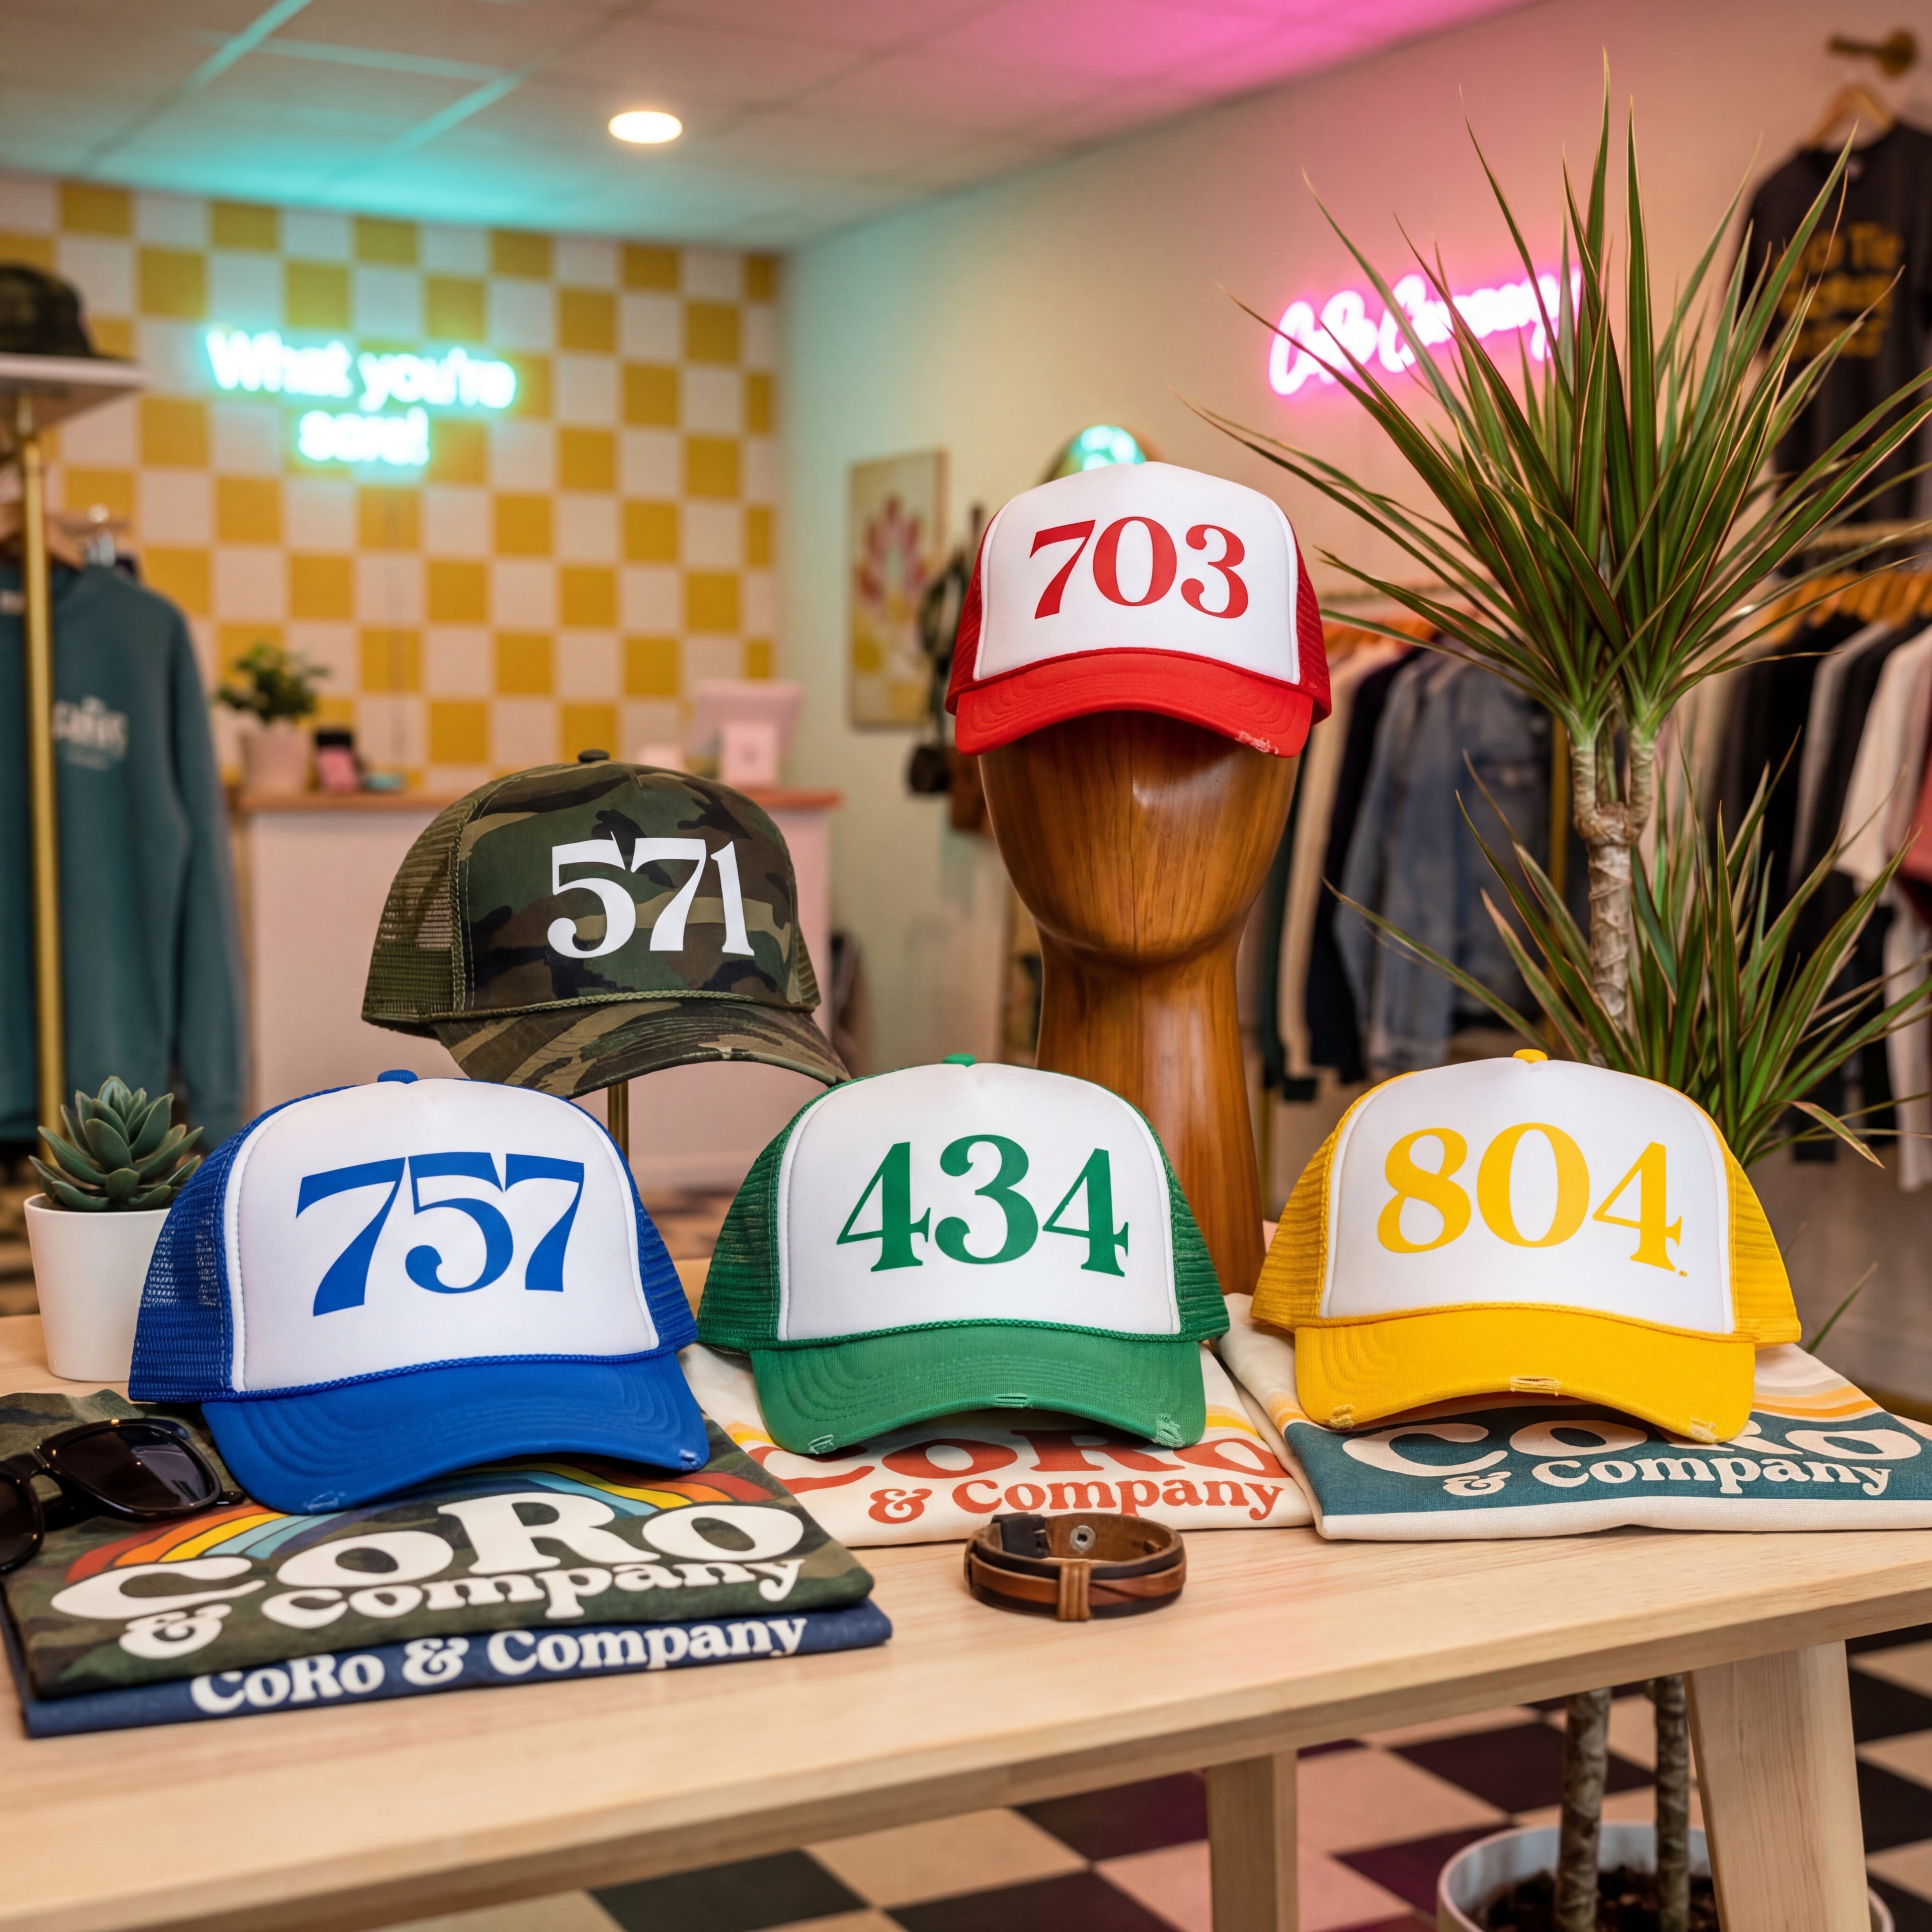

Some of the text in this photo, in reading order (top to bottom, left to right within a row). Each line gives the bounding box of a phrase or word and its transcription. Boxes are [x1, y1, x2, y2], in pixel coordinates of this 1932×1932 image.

[206, 330, 352, 398] What
[1029, 516, 1248, 619] 703
[547, 831, 755, 958] 571
[296, 1152, 585, 1317] 757
[836, 1135, 1129, 1277] 434
[1377, 1122, 1682, 1272] 804
[869, 1480, 1283, 1524] & Company
[1442, 1457, 1892, 1496] & Company
[51, 1492, 804, 1619] CoRo
[119, 1604, 231, 1659] &
[191, 1618, 808, 1713] CoRo & Company
